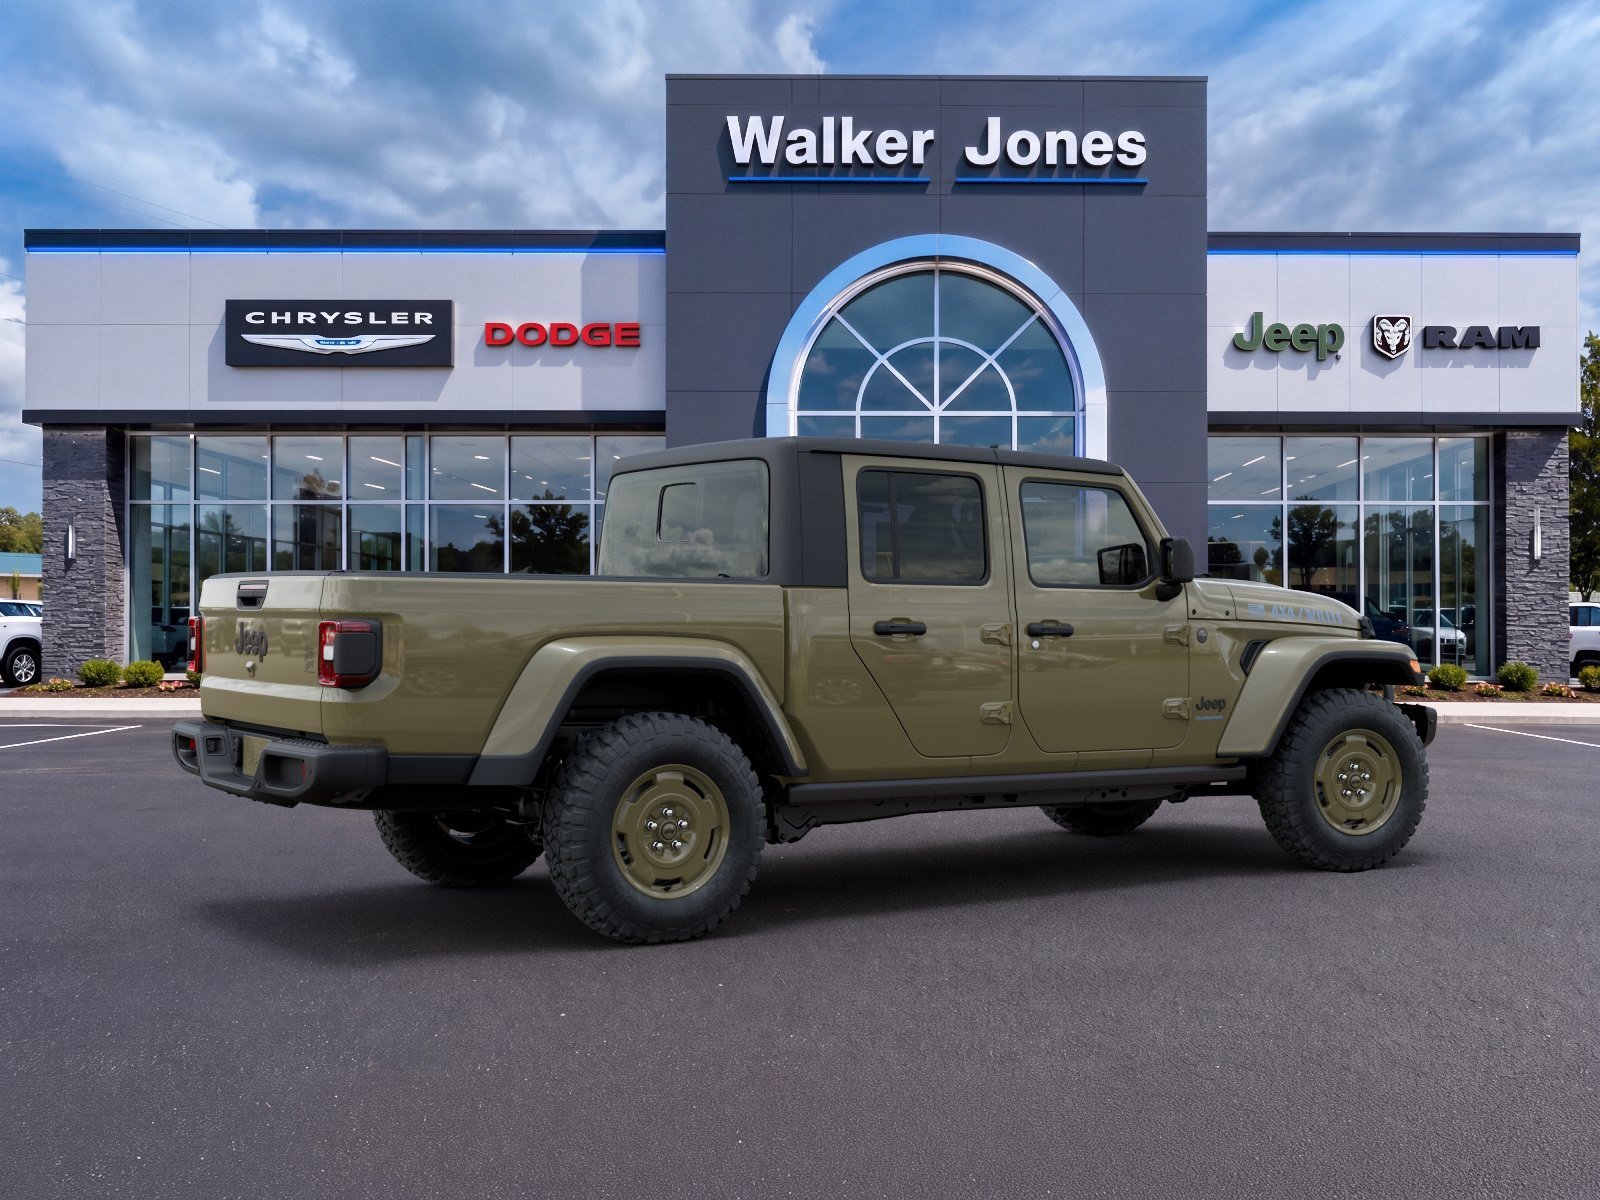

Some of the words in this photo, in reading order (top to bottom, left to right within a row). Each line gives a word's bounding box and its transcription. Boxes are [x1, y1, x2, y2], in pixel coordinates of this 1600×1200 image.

[725, 115, 935, 166] Walker
[964, 116, 1148, 167] Jones
[245, 311, 433, 325] CHRYSLER
[485, 322, 641, 347] DODGE
[1233, 311, 1345, 361] Jeep
[1423, 325, 1541, 349] RAM
[235, 621, 268, 663] Jeep
[1195, 695, 1227, 713] Jeep
